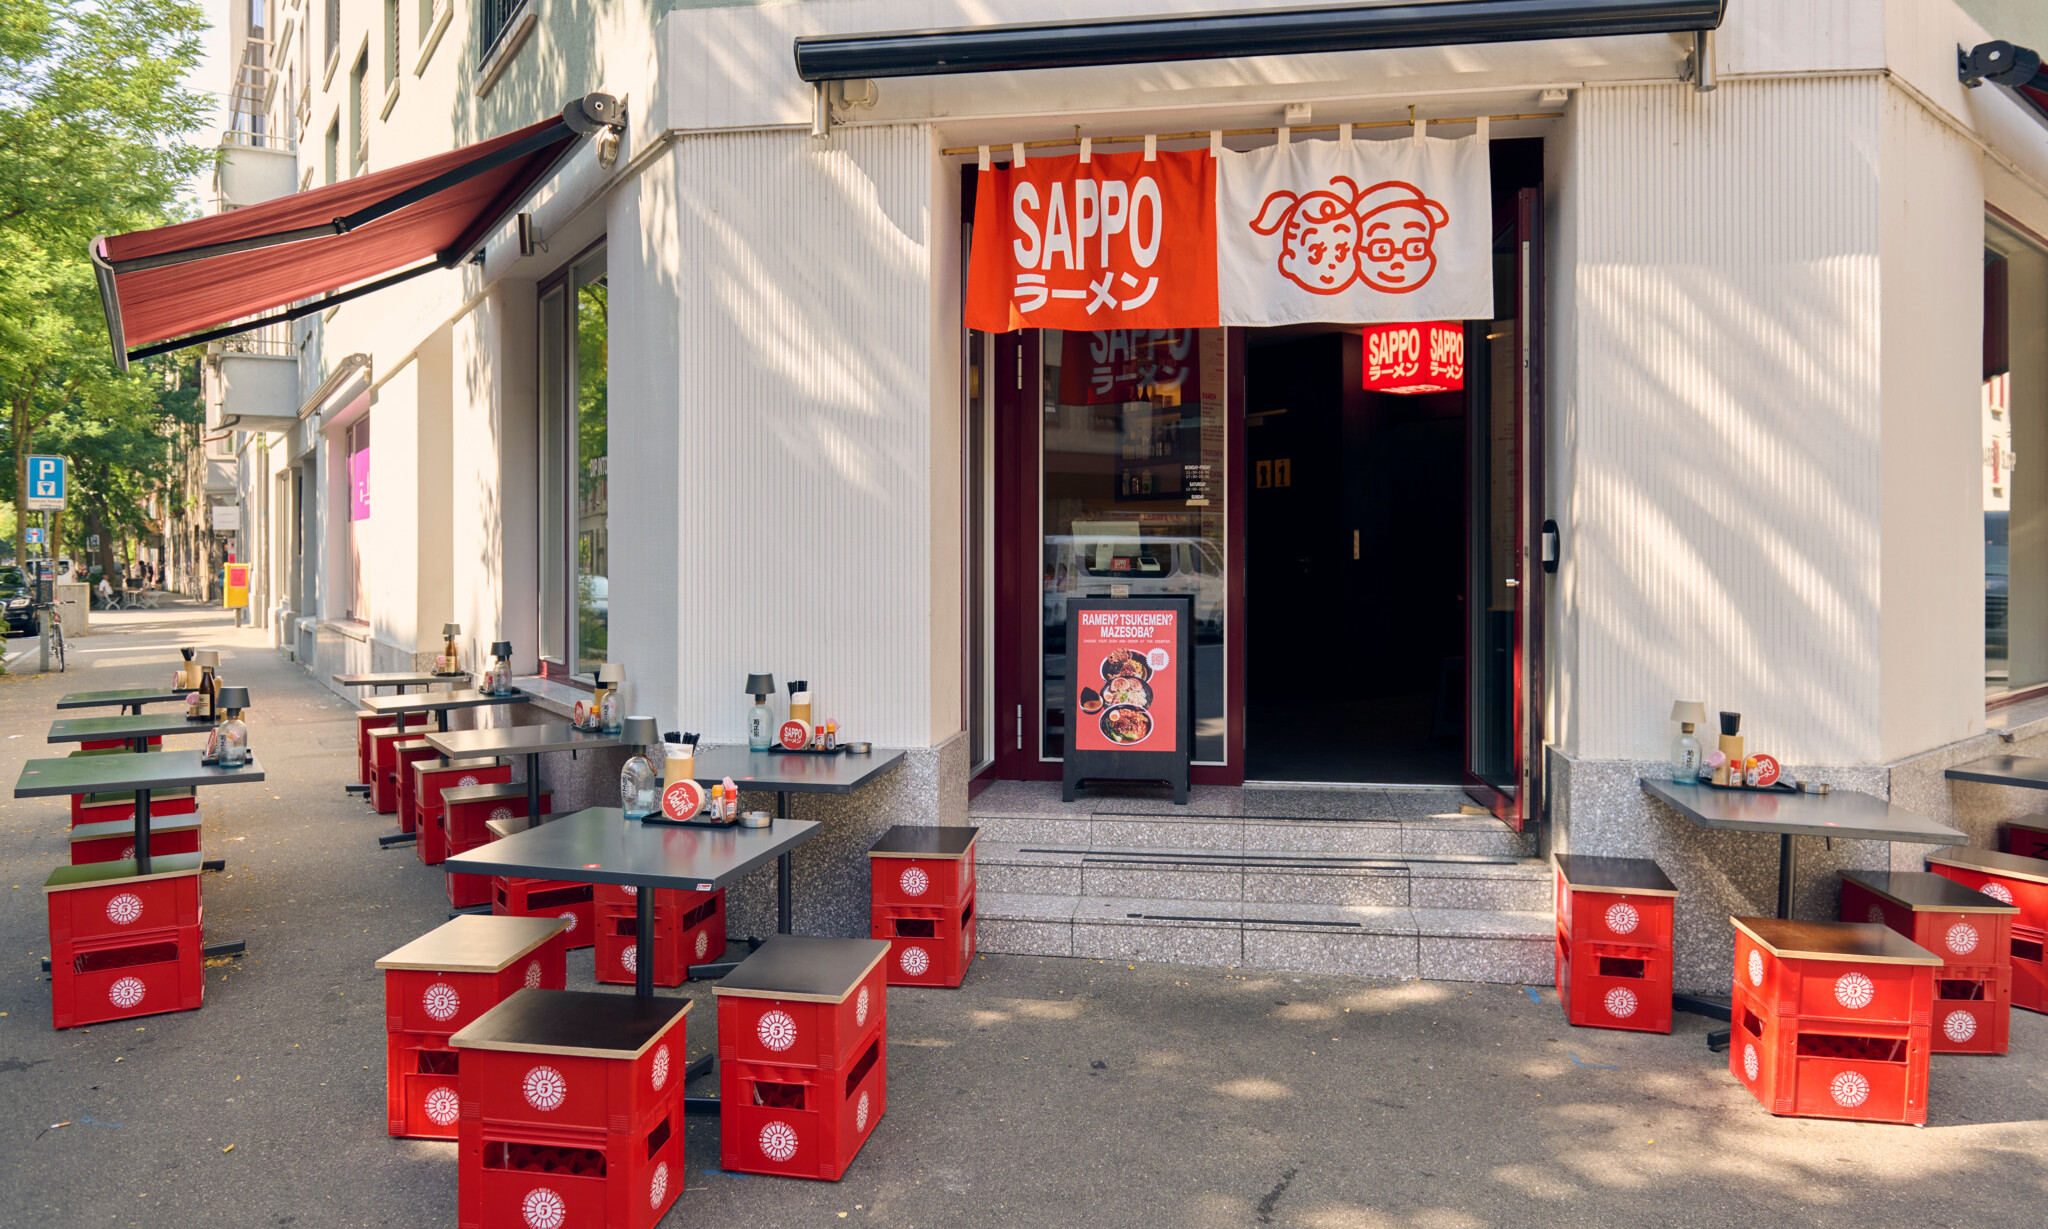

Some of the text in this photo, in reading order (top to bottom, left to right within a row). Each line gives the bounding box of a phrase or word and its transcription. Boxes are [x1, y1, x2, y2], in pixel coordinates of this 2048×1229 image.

[1013, 176, 1163, 270] SAPPO
[1014, 271, 1159, 315] ラーメン
[1369, 328, 1420, 366] SAPPO
[1430, 328, 1464, 366] SAPPO
[1369, 362, 1419, 381] ラーメン
[1430, 361, 1463, 380] ラーメン
[39, 460, 55, 480] P
[1082, 613, 1174, 626] RAMEN? TSUKEMEN?
[1100, 626, 1155, 638] MAZESOBA?
[784, 726, 802, 741] SAPPO
[1754, 758, 1774, 775] APPO
[668, 790, 689, 817] SAPPO
[911, 877, 918, 886] 5
[121, 904, 128, 913] 5
[1619, 914, 1625, 922] 5
[1958, 934, 1965, 943] 5
[911, 957, 918, 965] 5
[124, 988, 131, 997] 5
[1850, 986, 1858, 995] 5
[437, 997, 445, 1007] 5
[1618, 998, 1624, 1006] 5
[772, 1026, 781, 1036] 5
[1956, 1022, 1963, 1031] 5
[540, 1083, 549, 1094] 5
[1846, 1084, 1854, 1093] 5
[440, 1101, 447, 1111] 5
[774, 1136, 782, 1146] 5
[540, 1204, 548, 1215] 5
